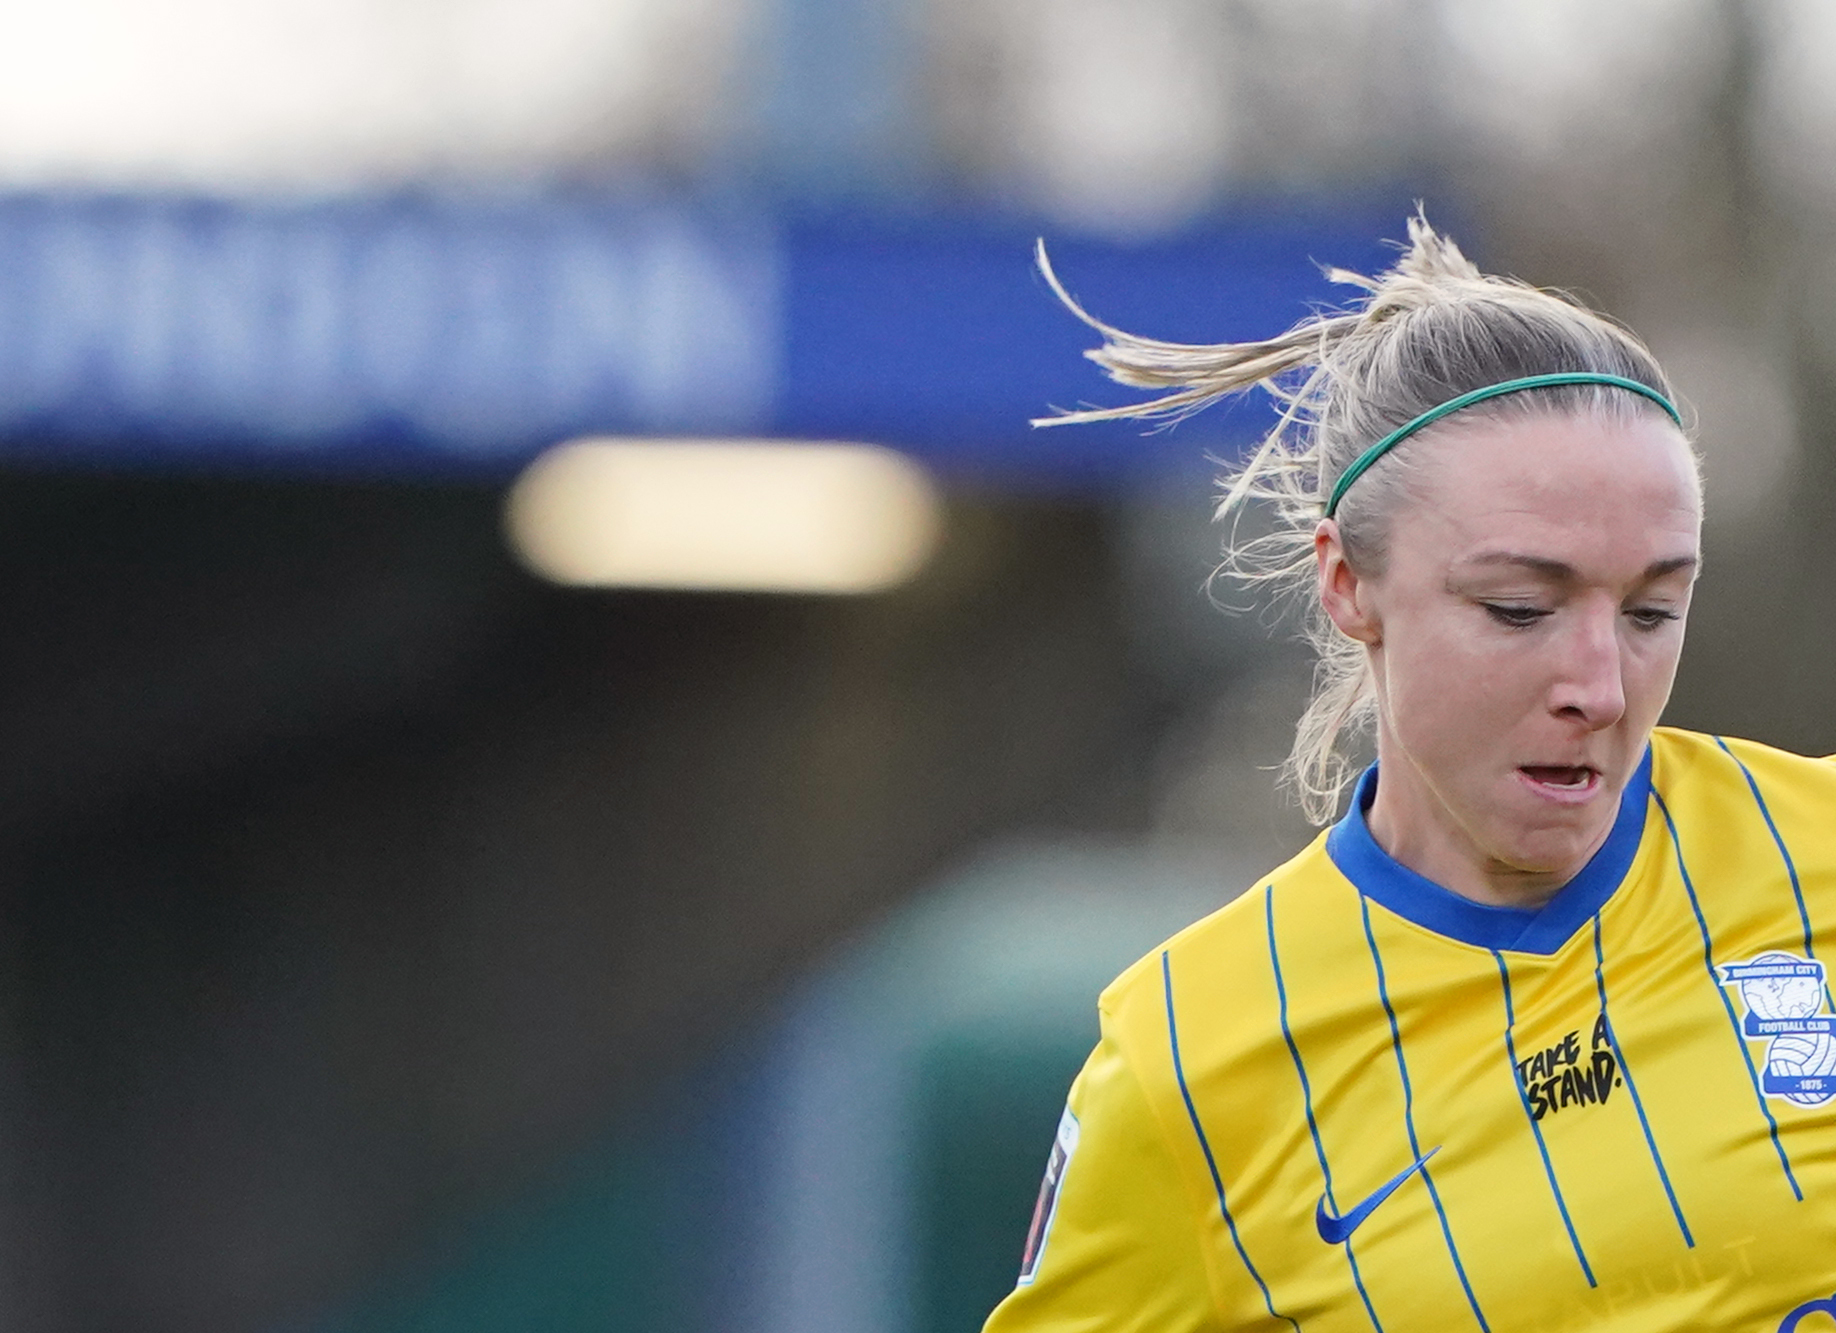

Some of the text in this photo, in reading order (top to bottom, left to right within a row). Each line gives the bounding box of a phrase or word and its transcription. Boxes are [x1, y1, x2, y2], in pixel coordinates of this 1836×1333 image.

[1796, 965, 1818, 975] CITY
[1758, 1021, 1830, 1033] FOOTBALL CLUB
[1515, 1012, 1612, 1088] TAKE A
[1527, 1050, 1622, 1121] STAND.
